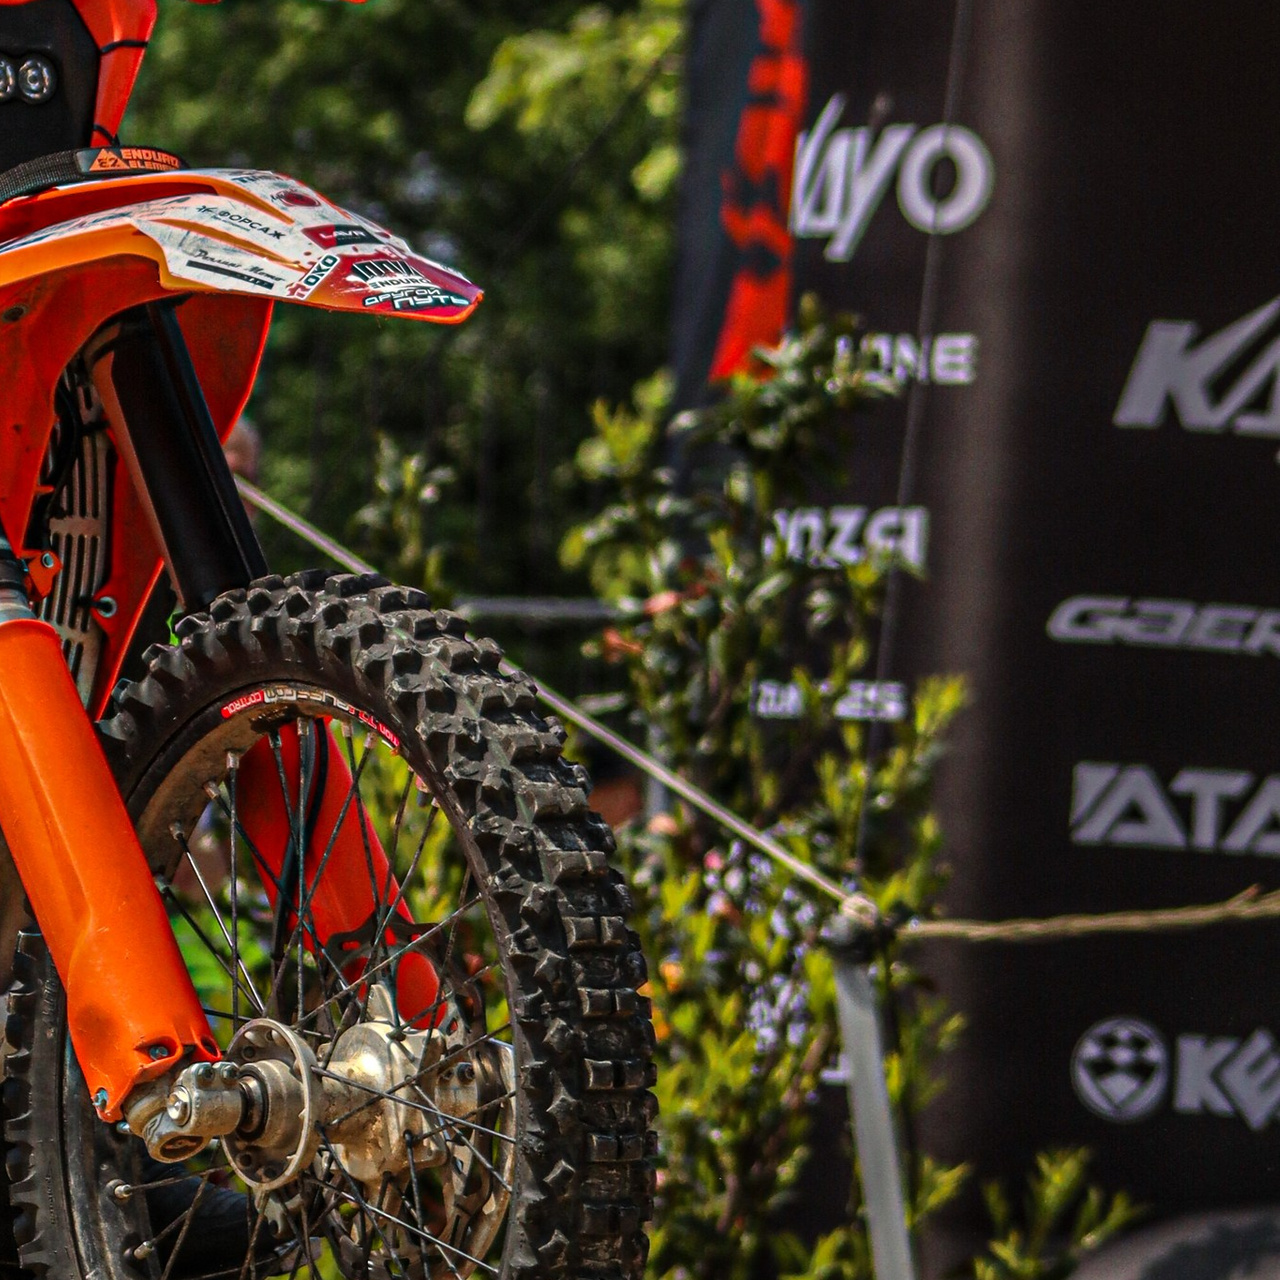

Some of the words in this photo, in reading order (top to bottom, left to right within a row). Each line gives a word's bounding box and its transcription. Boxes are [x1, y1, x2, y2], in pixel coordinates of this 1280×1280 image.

[120, 147, 180, 169] ENDURO
[219, 207, 286, 240] ФОРСАЖ
[365, 286, 441, 306] ДРУГОЙ
[393, 295, 470, 310] ПУТЬ
